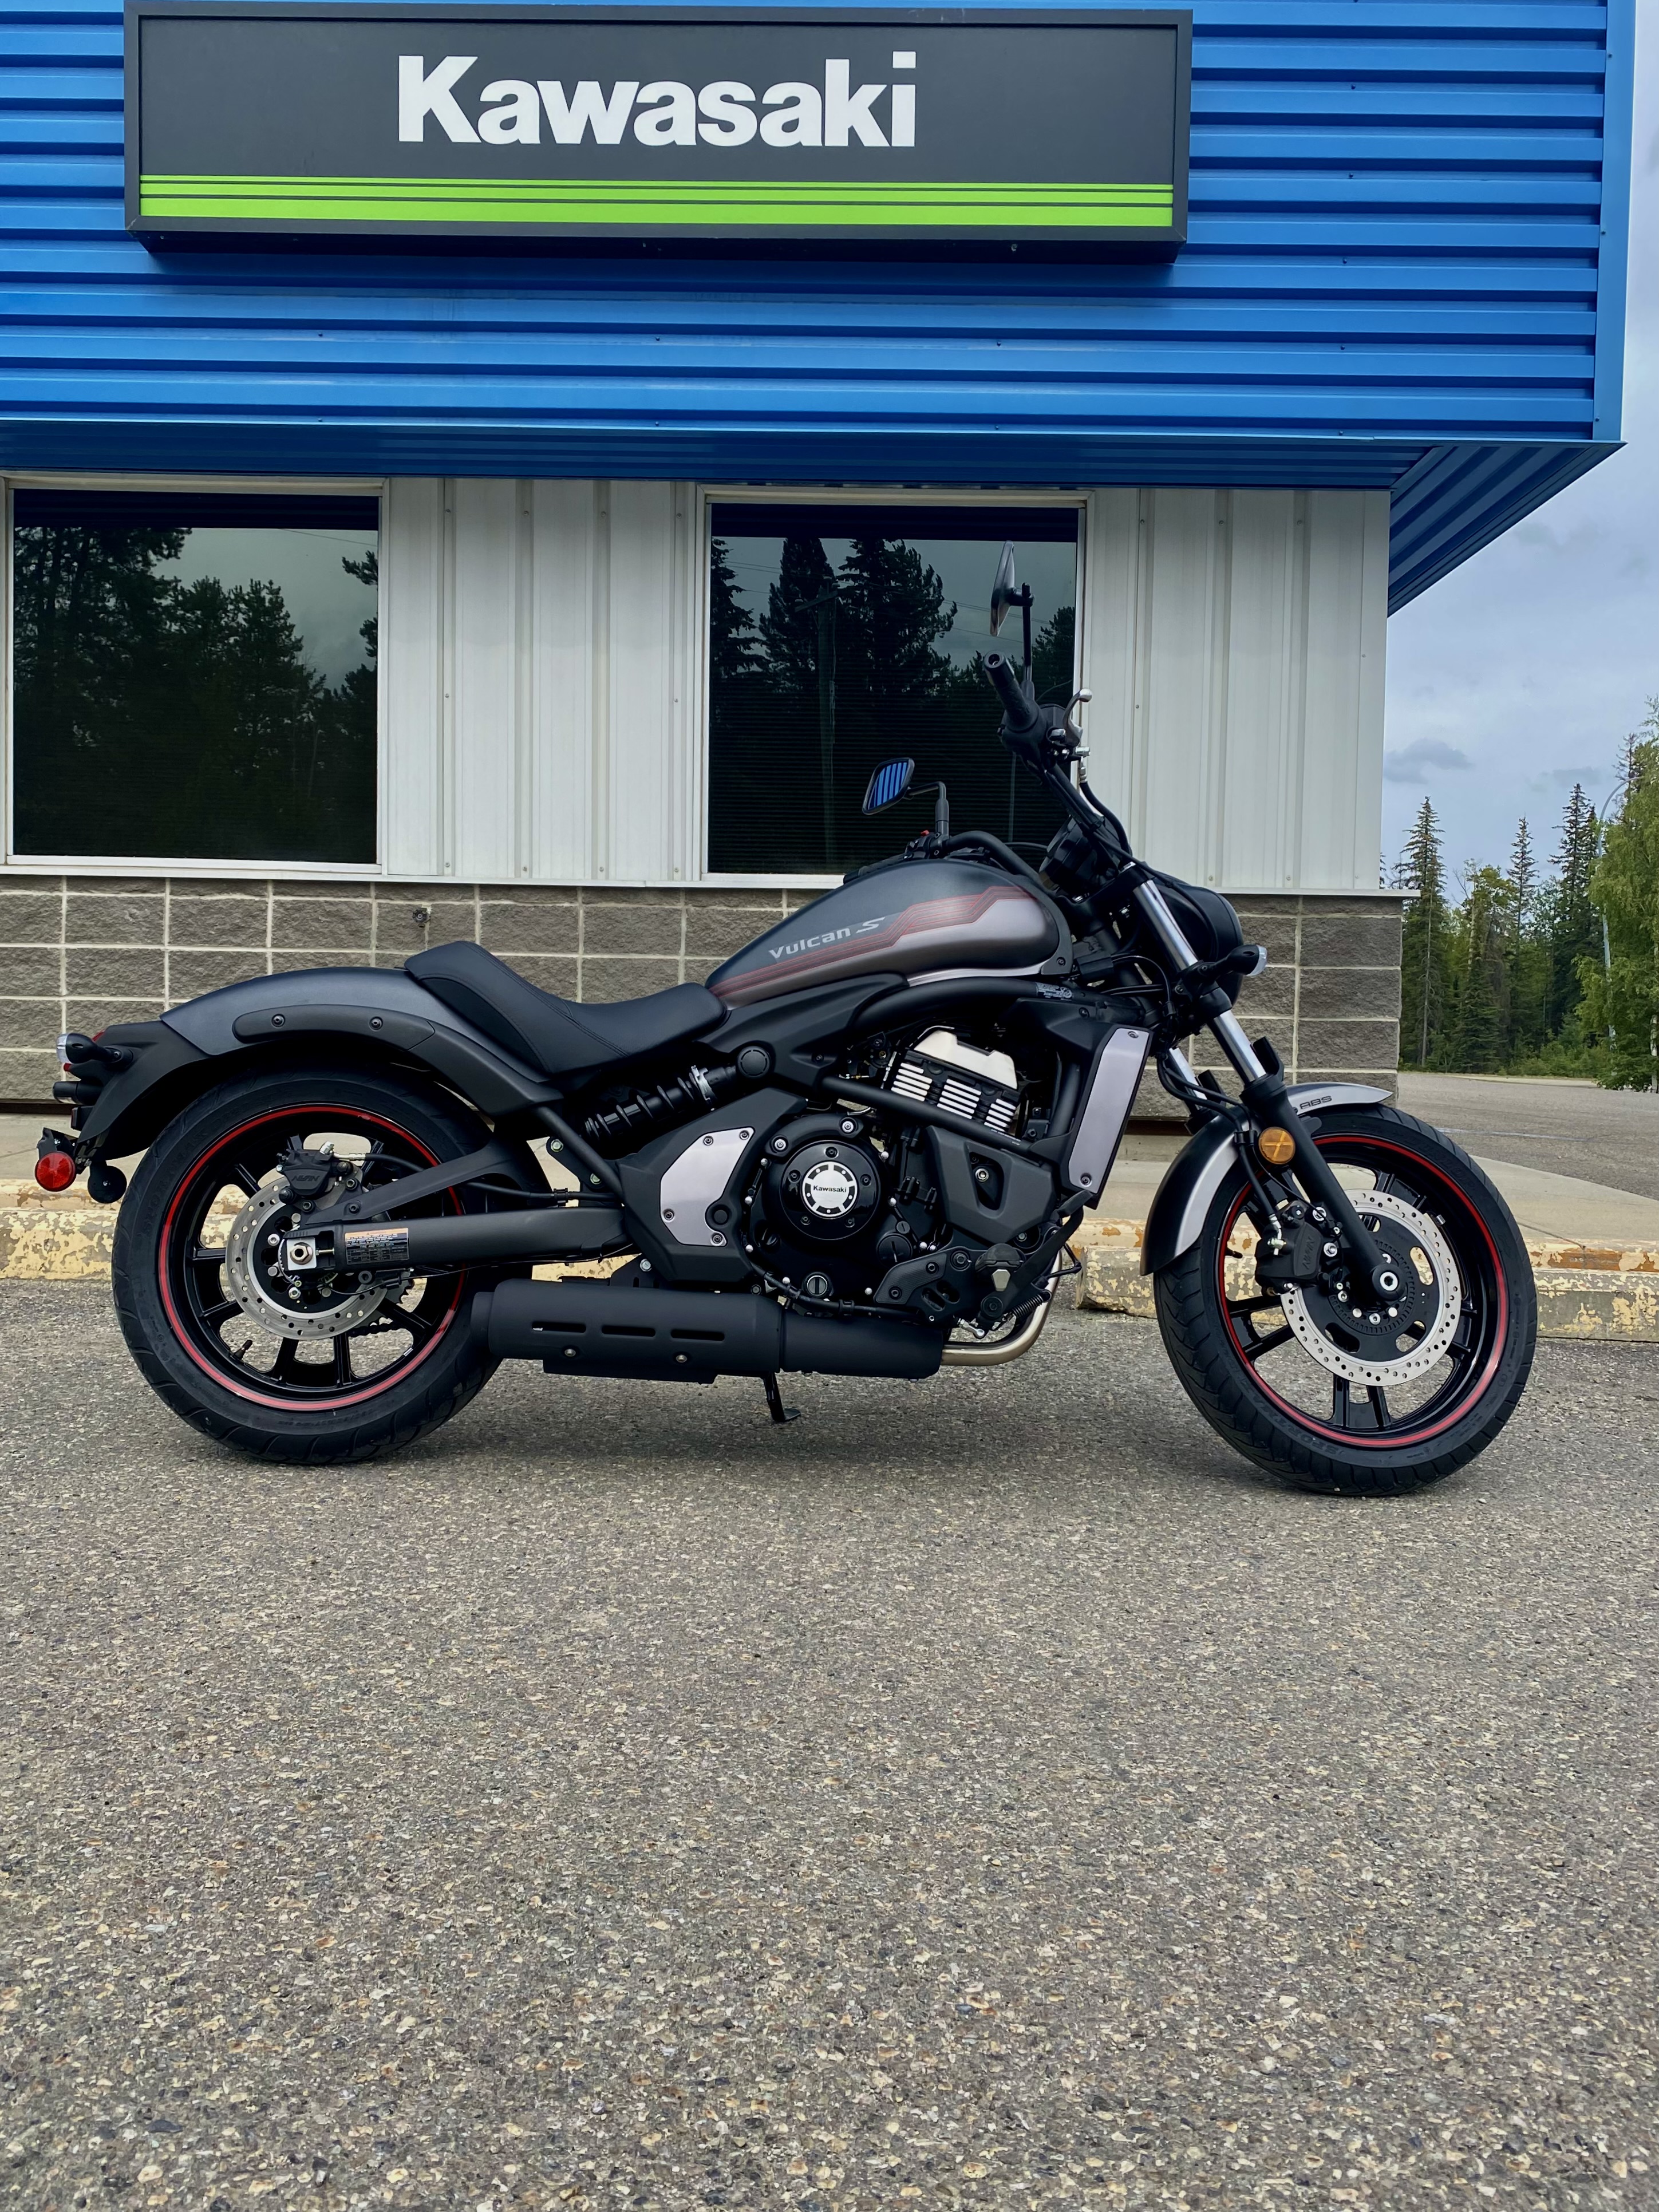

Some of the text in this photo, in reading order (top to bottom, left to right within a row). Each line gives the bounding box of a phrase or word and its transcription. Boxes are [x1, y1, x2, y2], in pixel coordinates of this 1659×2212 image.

[398, 51, 917, 147] Kawasaki
[856, 917, 886, 934] S
[1299, 1096, 1332, 1109] ABS
